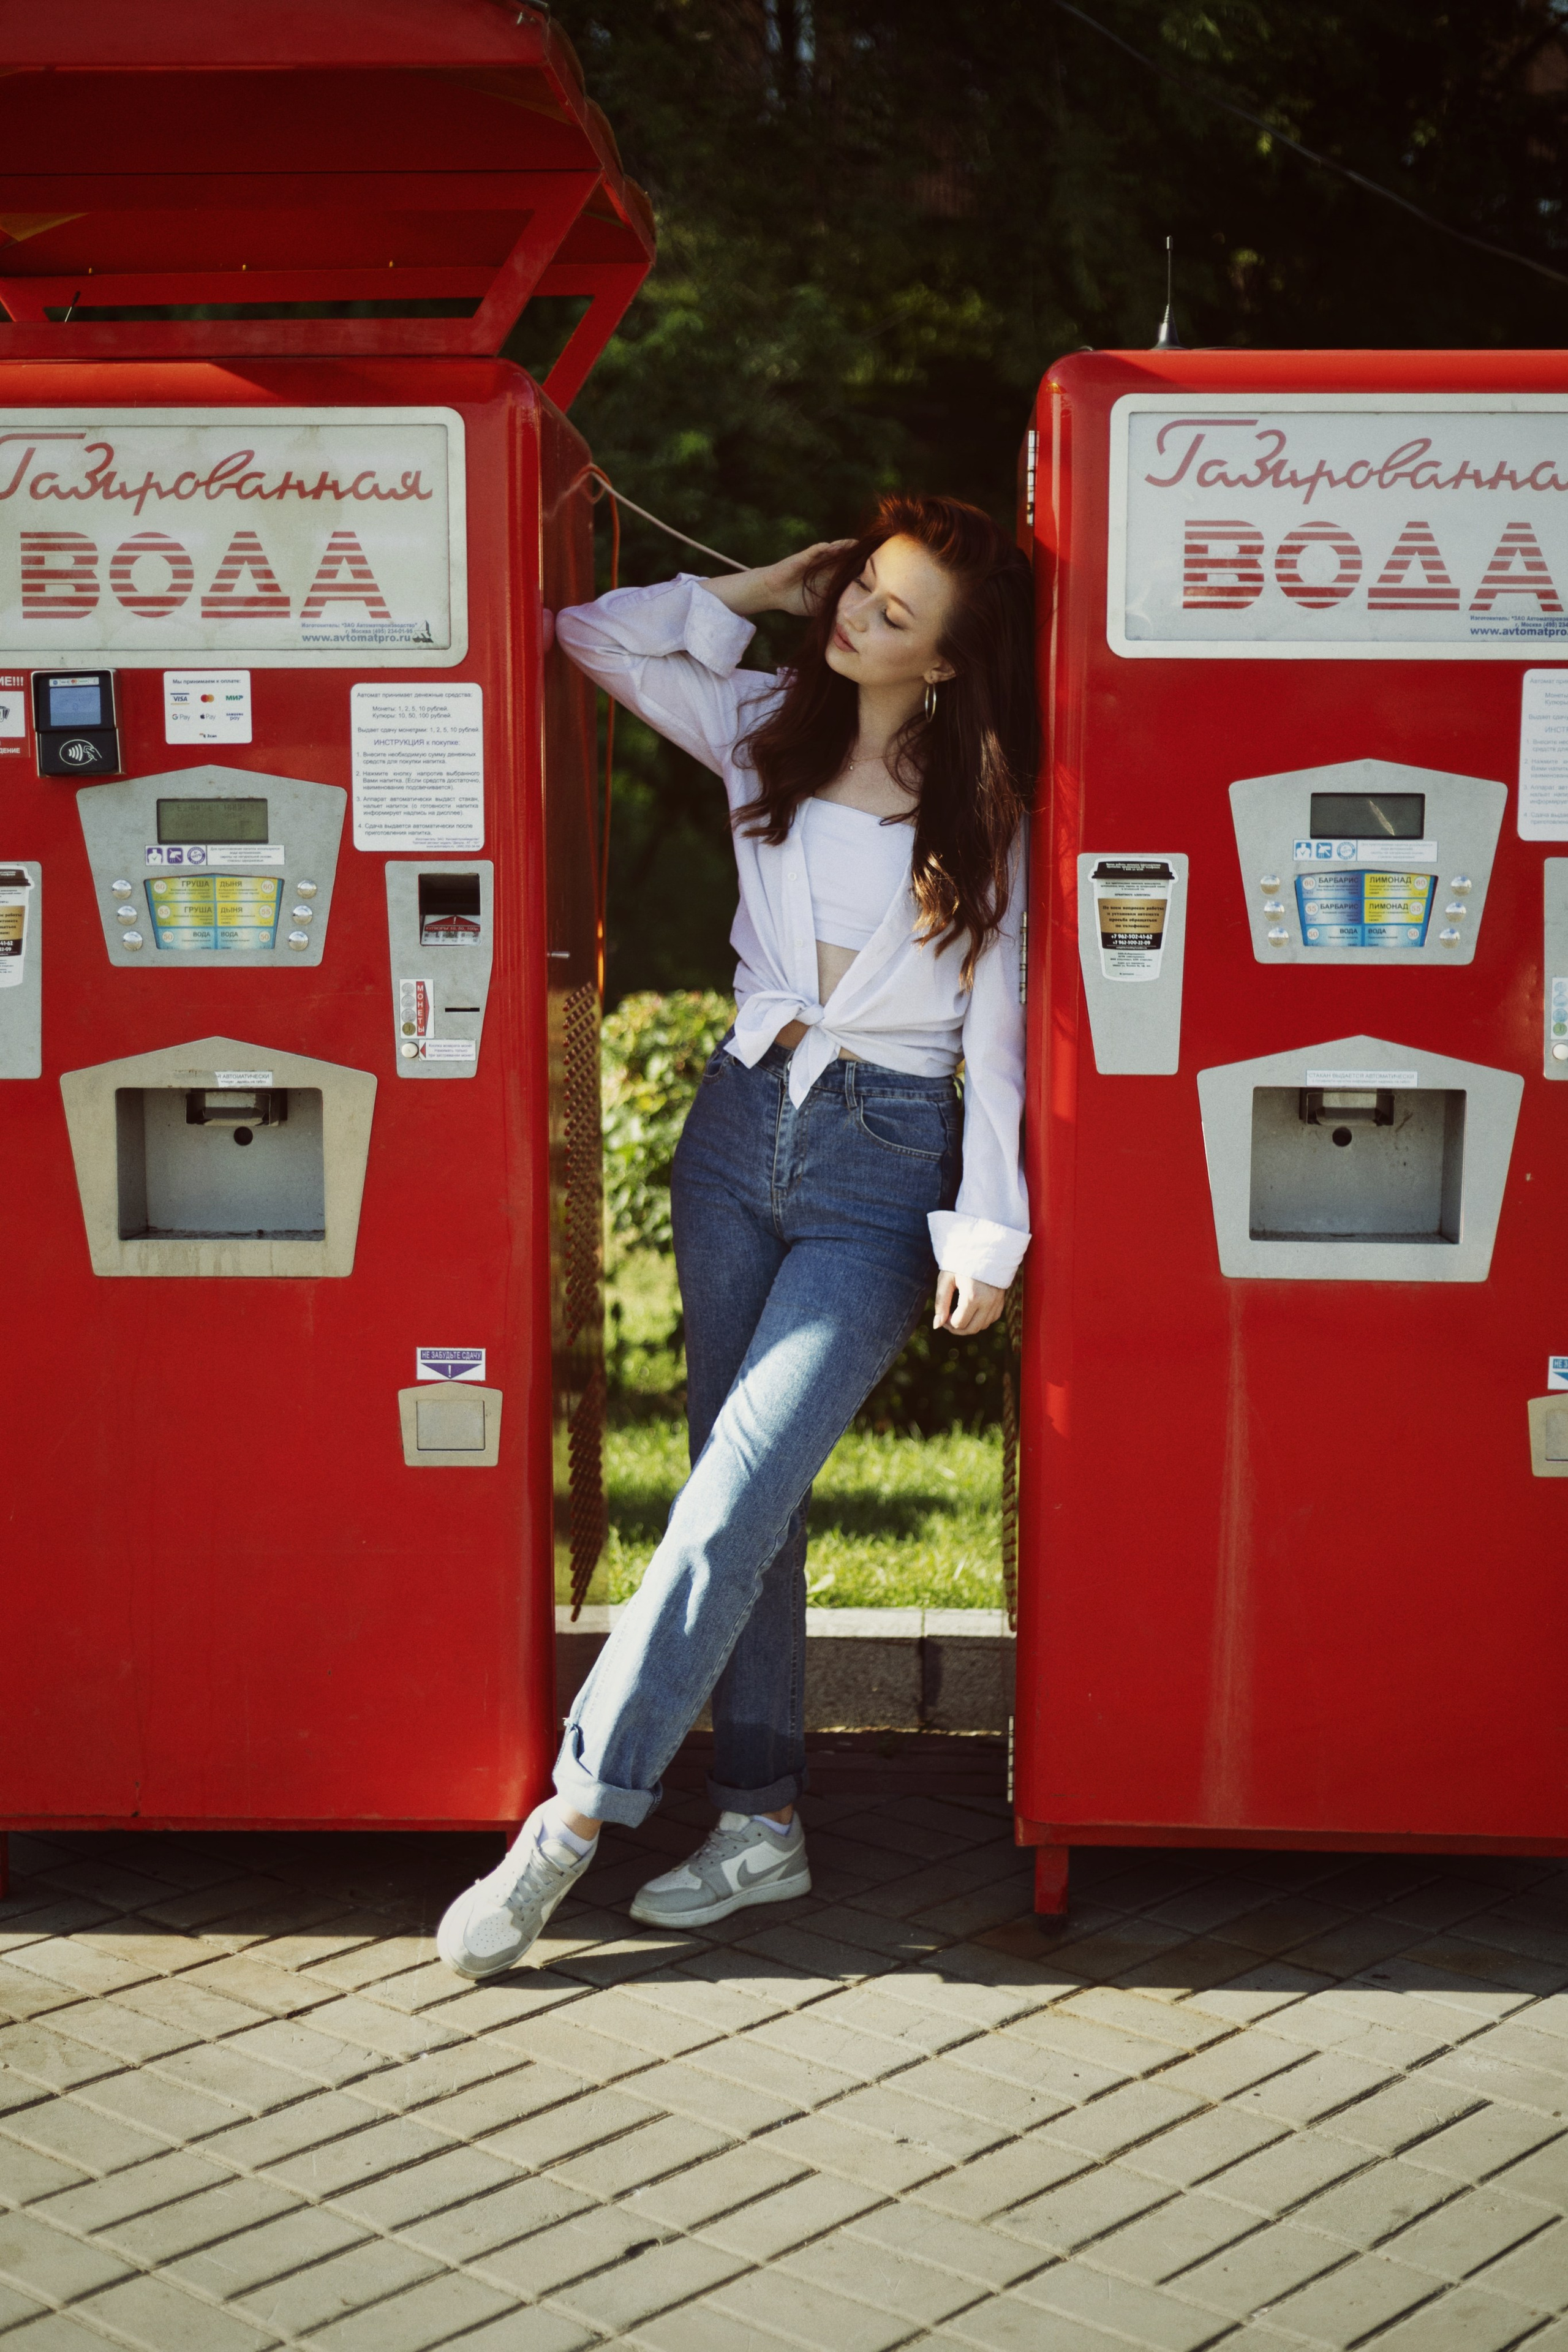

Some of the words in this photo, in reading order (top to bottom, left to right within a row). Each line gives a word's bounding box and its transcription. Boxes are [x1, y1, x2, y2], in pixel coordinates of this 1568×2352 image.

[0, 432, 432, 516] Газированная
[20, 531, 391, 619] ВОДА
[1183, 520, 1564, 612] ВОДА
[302, 633, 411, 643] www.avtomatpro.ru
